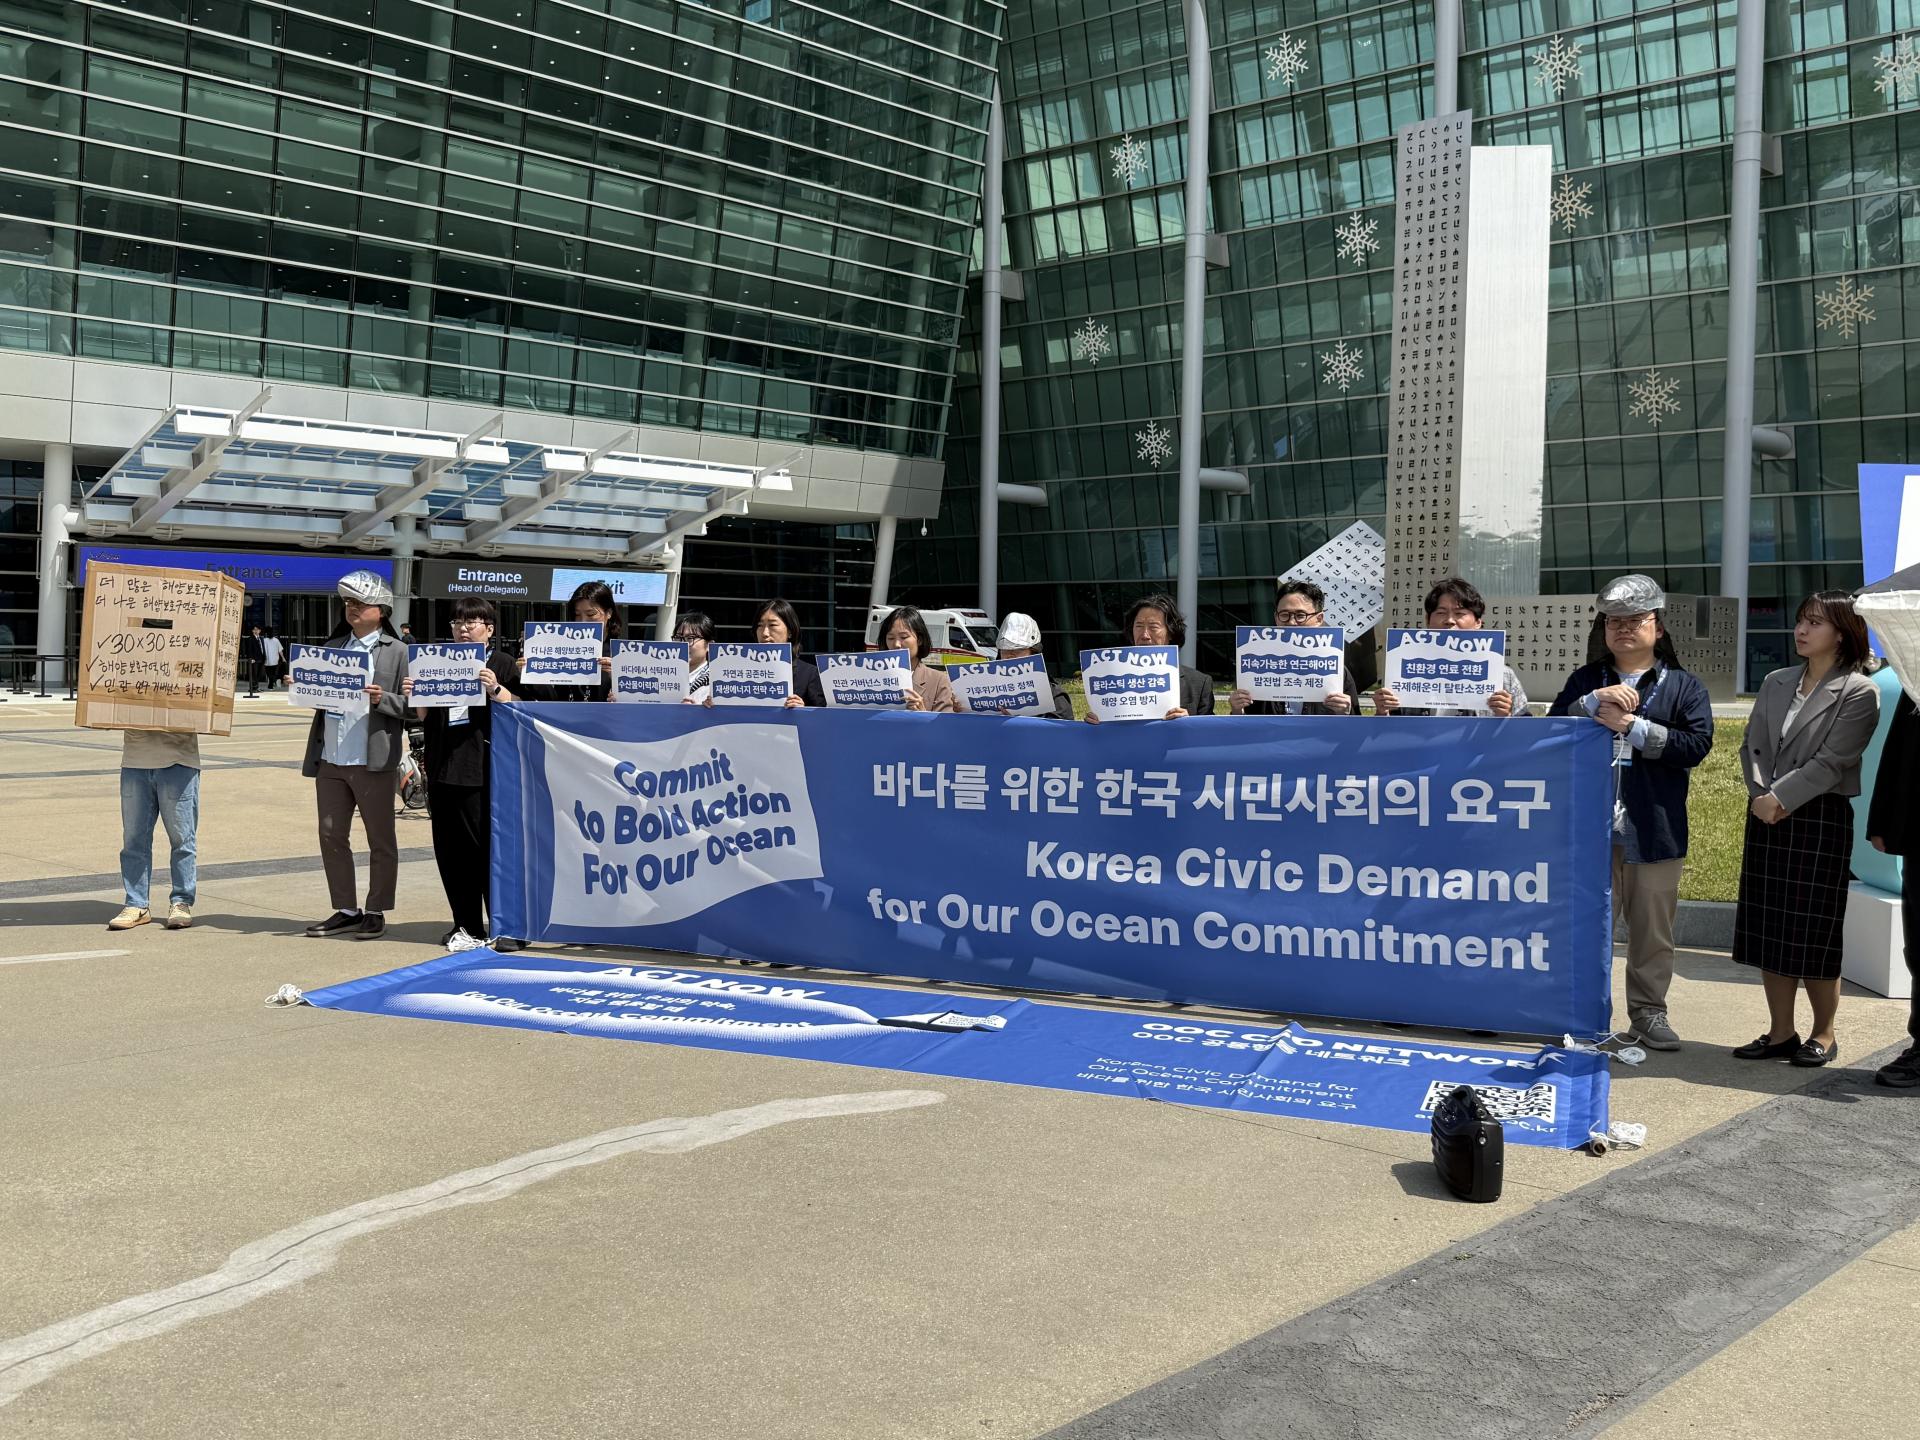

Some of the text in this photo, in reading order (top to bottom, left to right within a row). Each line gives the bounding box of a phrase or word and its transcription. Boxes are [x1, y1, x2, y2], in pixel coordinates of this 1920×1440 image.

[458, 568, 522, 583] Entrance
[99, 575, 217, 600] 더 많은 해양보호구역
[448, 584, 528, 596] (Head of Delegation)
[96, 594, 105, 607] 더
[534, 623, 595, 640] ACT NOW
[1248, 628, 1333, 648] ACT NOW
[169, 635, 191, 648] 로드맵
[194, 636, 211, 651] 제시
[1400, 630, 1493, 652] ACT NOW
[299, 647, 361, 668] ACT NOW
[417, 645, 477, 661] ACT NOW
[531, 646, 595, 655] 더 나은 해양보호구역
[619, 641, 680, 660] ACT NOW
[717, 644, 782, 662] ACT NOW
[1090, 649, 1168, 667] ACT NOW
[179, 661, 204, 678] 제정
[531, 660, 594, 670] 해양보호구역법 제정
[621, 666, 677, 676] 바다에서 식탁까지
[827, 655, 900, 671] ACT NOW
[959, 661, 1034, 677] ACT NOW
[1242, 658, 1337, 671] 지속가능한 연근해어업
[1406, 663, 1482, 675] 친환경 연료 전환
[296, 671, 361, 687] 더 많은 해양보호구역
[419, 668, 474, 677] 생산부터 수거까지
[723, 669, 775, 679] 자연과 공존하는
[136, 681, 151, 695] 연구
[152, 682, 181, 696] 거버넌스
[185, 683, 209, 699] 확대
[415, 683, 436, 693] 폐어구
[464, 682, 479, 691] 관리
[619, 680, 681, 692] 수산물이력제 의무화
[715, 685, 784, 695] 재생에너지 전략 수립
[833, 677, 899, 687] 민관 거버넌스 확대
[966, 680, 1035, 695] 기후위기대응 정책
[1093, 677, 1166, 691] 플라스틱 생산 감축
[1254, 677, 1324, 688] 발전법 조속 제정
[1392, 681, 1496, 695] 국제해운의 탈탄소정책
[323, 690, 345, 700] 로드맵
[346, 692, 362, 701] 제시
[837, 692, 900, 701] 해양시민과학 지원
[973, 694, 1035, 709] 선택이 아닌 필수
[1101, 694, 1157, 707] 해양 오염 방지
[613, 748, 734, 798] Commit
[873, 761, 1551, 830] 바다를 위한 한국 시민사회의 요구
[574, 784, 791, 845] to Bold Action
[583, 826, 796, 895] For Our Ocean
[1026, 841, 1549, 904] Korea Civic Demand
[867, 888, 1550, 972] for Our Ocean Commitment
[1132, 1031, 1196, 1043] OOC
[1305, 1049, 1411, 1067] 네트워크
[1142, 1023, 1235, 1038] OOC
[1331, 1041, 1566, 1070] NETWORK
[1088, 1064, 1128, 1073] Our
[1132, 1068, 1198, 1081] Ocean
[1173, 1067, 1222, 1077] Civic
[1328, 1083, 1359, 1092] for
[1076, 1072, 1130, 1083] 바다를
[1176, 1083, 1212, 1094] 한국
[1317, 1101, 1358, 1110] 요구
